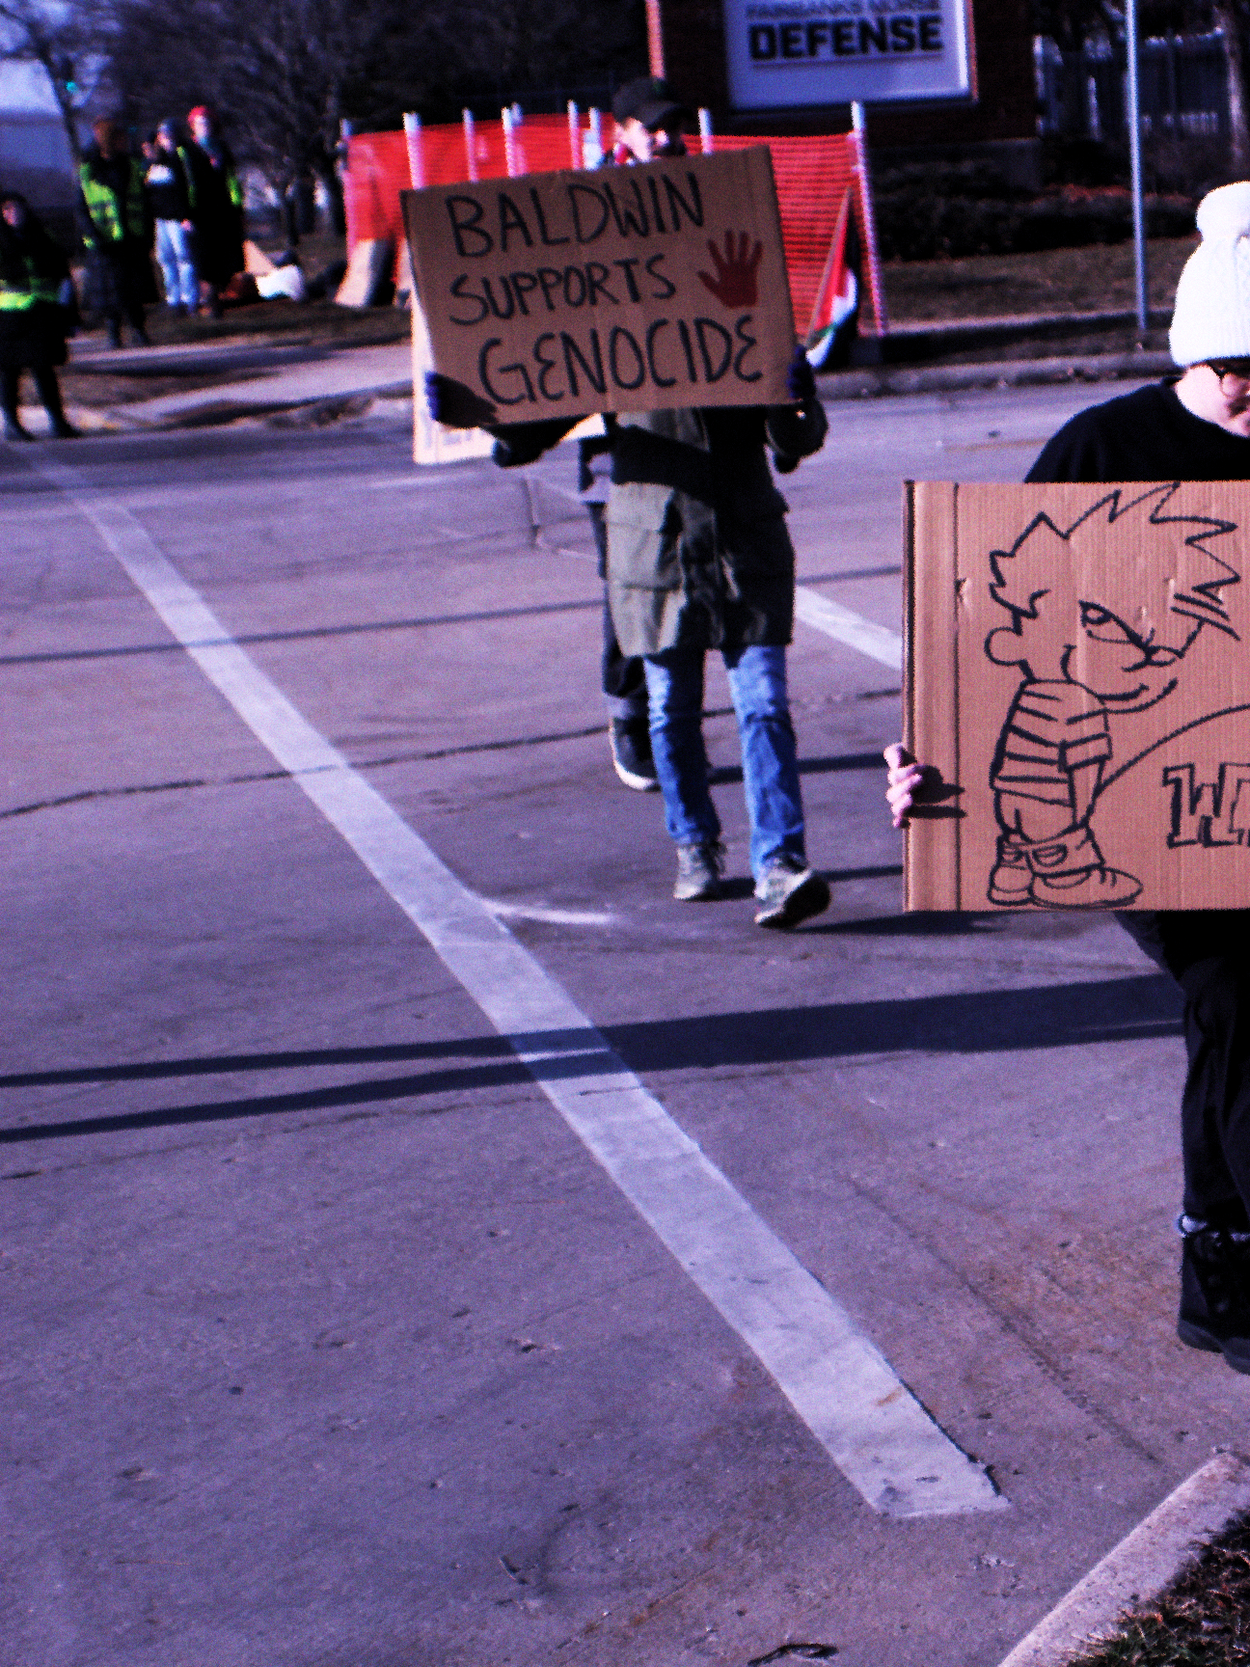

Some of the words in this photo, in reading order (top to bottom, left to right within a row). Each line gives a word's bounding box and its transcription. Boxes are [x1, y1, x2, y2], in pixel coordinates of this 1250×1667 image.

[750, 14, 944, 60] DEFENSE
[445, 171, 704, 257] BALDWIN
[449, 253, 677, 326] SUPPORTS
[478, 315, 763, 405] GENOCIDE
